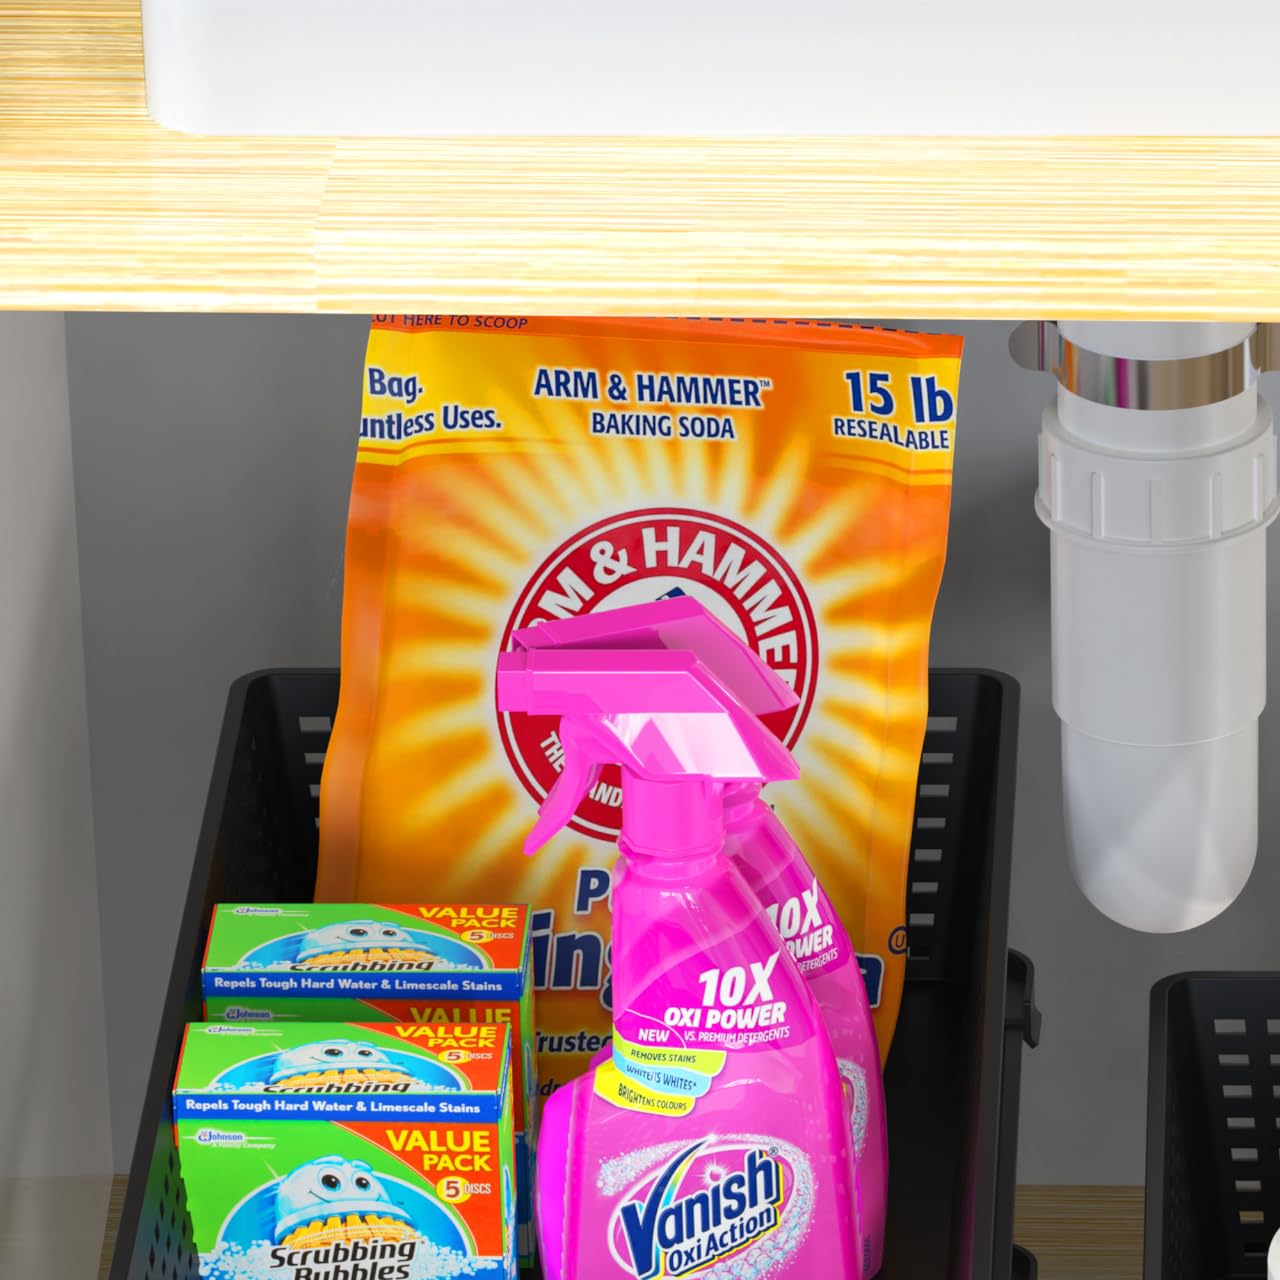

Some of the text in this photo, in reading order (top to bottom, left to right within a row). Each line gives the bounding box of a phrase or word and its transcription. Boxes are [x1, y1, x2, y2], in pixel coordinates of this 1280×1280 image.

[372, 314, 528, 329] UT HERE TO SCOOP
[368, 368, 423, 404] Bag.
[534, 368, 599, 399] ARM
[607, 373, 628, 401] &
[845, 371, 954, 423] 15 lb
[443, 405, 502, 430] Uses.
[592, 412, 735, 439] BAKING SODA
[834, 418, 949, 450] RESEALABLE
[589, 540, 638, 585] &
[419, 907, 519, 919] VALUE
[451, 918, 517, 928] PACK
[469, 932, 484, 941] 5
[214, 976, 503, 991] Repels Tough Hard Water & Limescale Stains
[698, 948, 782, 1007] 10X
[664, 1002, 787, 1029] OXI POWER
[395, 1025, 496, 1038] VALUE
[638, 1028, 670, 1042] NEW
[684, 1026, 790, 1045] VS. PREMIUM DETERGENTS
[427, 1038, 496, 1048] PACK
[536, 1031, 613, 1053] ruste
[447, 1052, 461, 1061] 5
[631, 1049, 697, 1063] REMOVES STAINS
[186, 1099, 481, 1114] Repels Tough Hard Water & Limescale Stains
[618, 1083, 687, 1111] BRIGHTENS COLOURS
[385, 1129, 491, 1152] VALUE
[423, 1154, 493, 1172] PACK
[445, 1180, 491, 1198] 5 DISCS
[269, 1240, 416, 1268] Scrubbing
